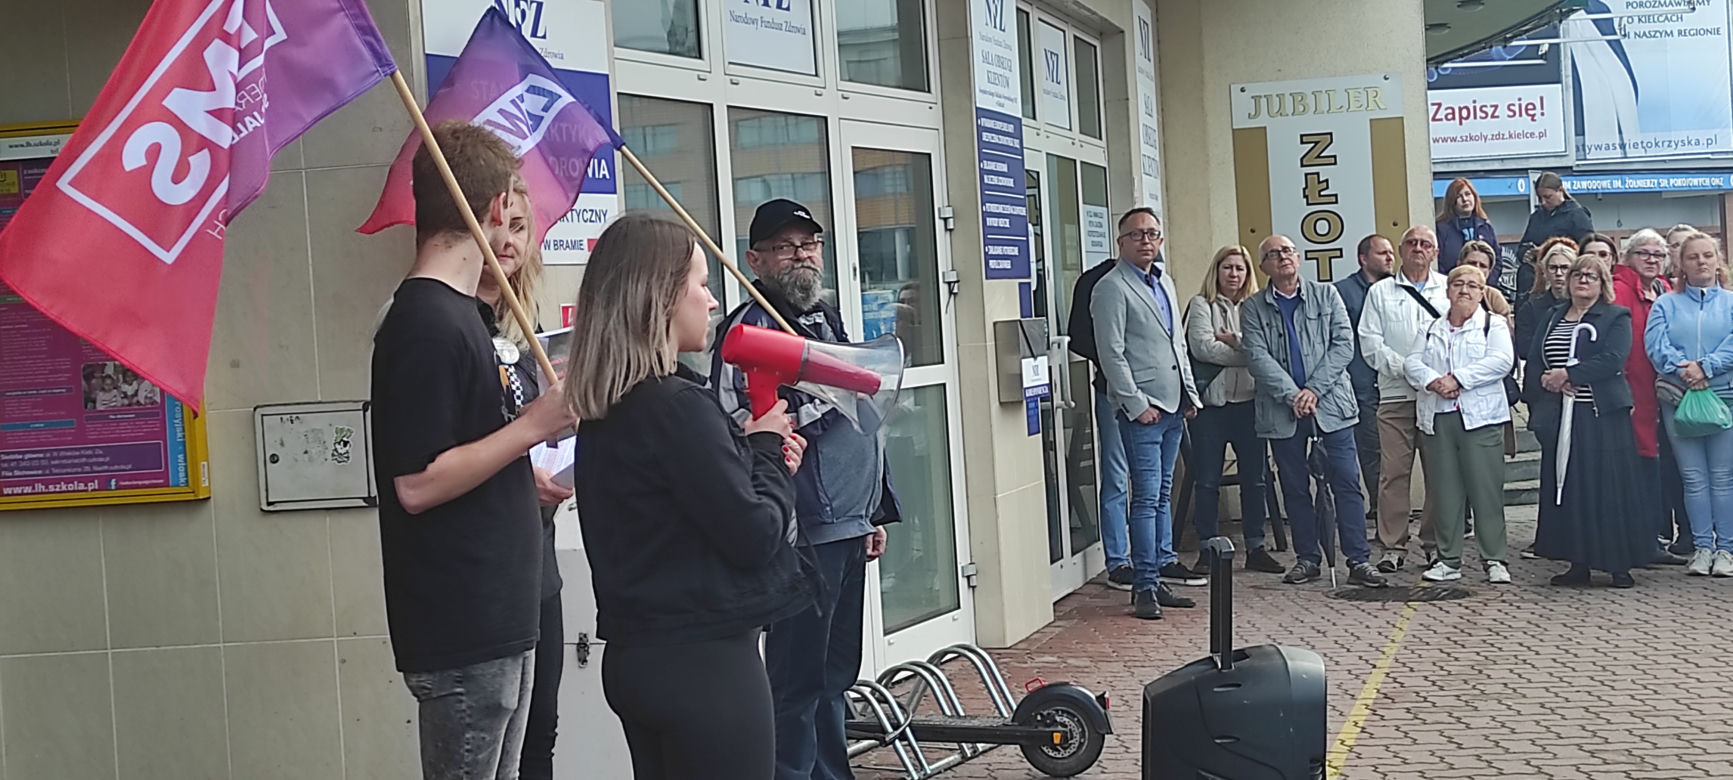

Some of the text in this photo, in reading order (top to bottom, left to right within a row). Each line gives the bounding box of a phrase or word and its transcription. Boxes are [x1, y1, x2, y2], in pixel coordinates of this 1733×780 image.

[1626, 0, 1711, 9] POROZMAWIMY
[729, 10, 806, 35] Narodowy Fundusz Zdrowia
[984, 0, 1006, 32] NFZ
[1626, 14, 1684, 24] O KIELCACH
[1634, 30, 1674, 39] NASZYM
[1678, 27, 1722, 38] REGIONIE
[1044, 48, 1061, 85] NFZ
[1248, 86, 1387, 119] JUBILER
[1430, 95, 1546, 126] Zapisz się!
[1431, 128, 1548, 144] www.szkoly.zdz.kielce.pl
[559, 208, 608, 224] KTYCZNY
[553, 239, 584, 251] BRAMIE
[3, 480, 99, 495] www.lh.szkola.pl
